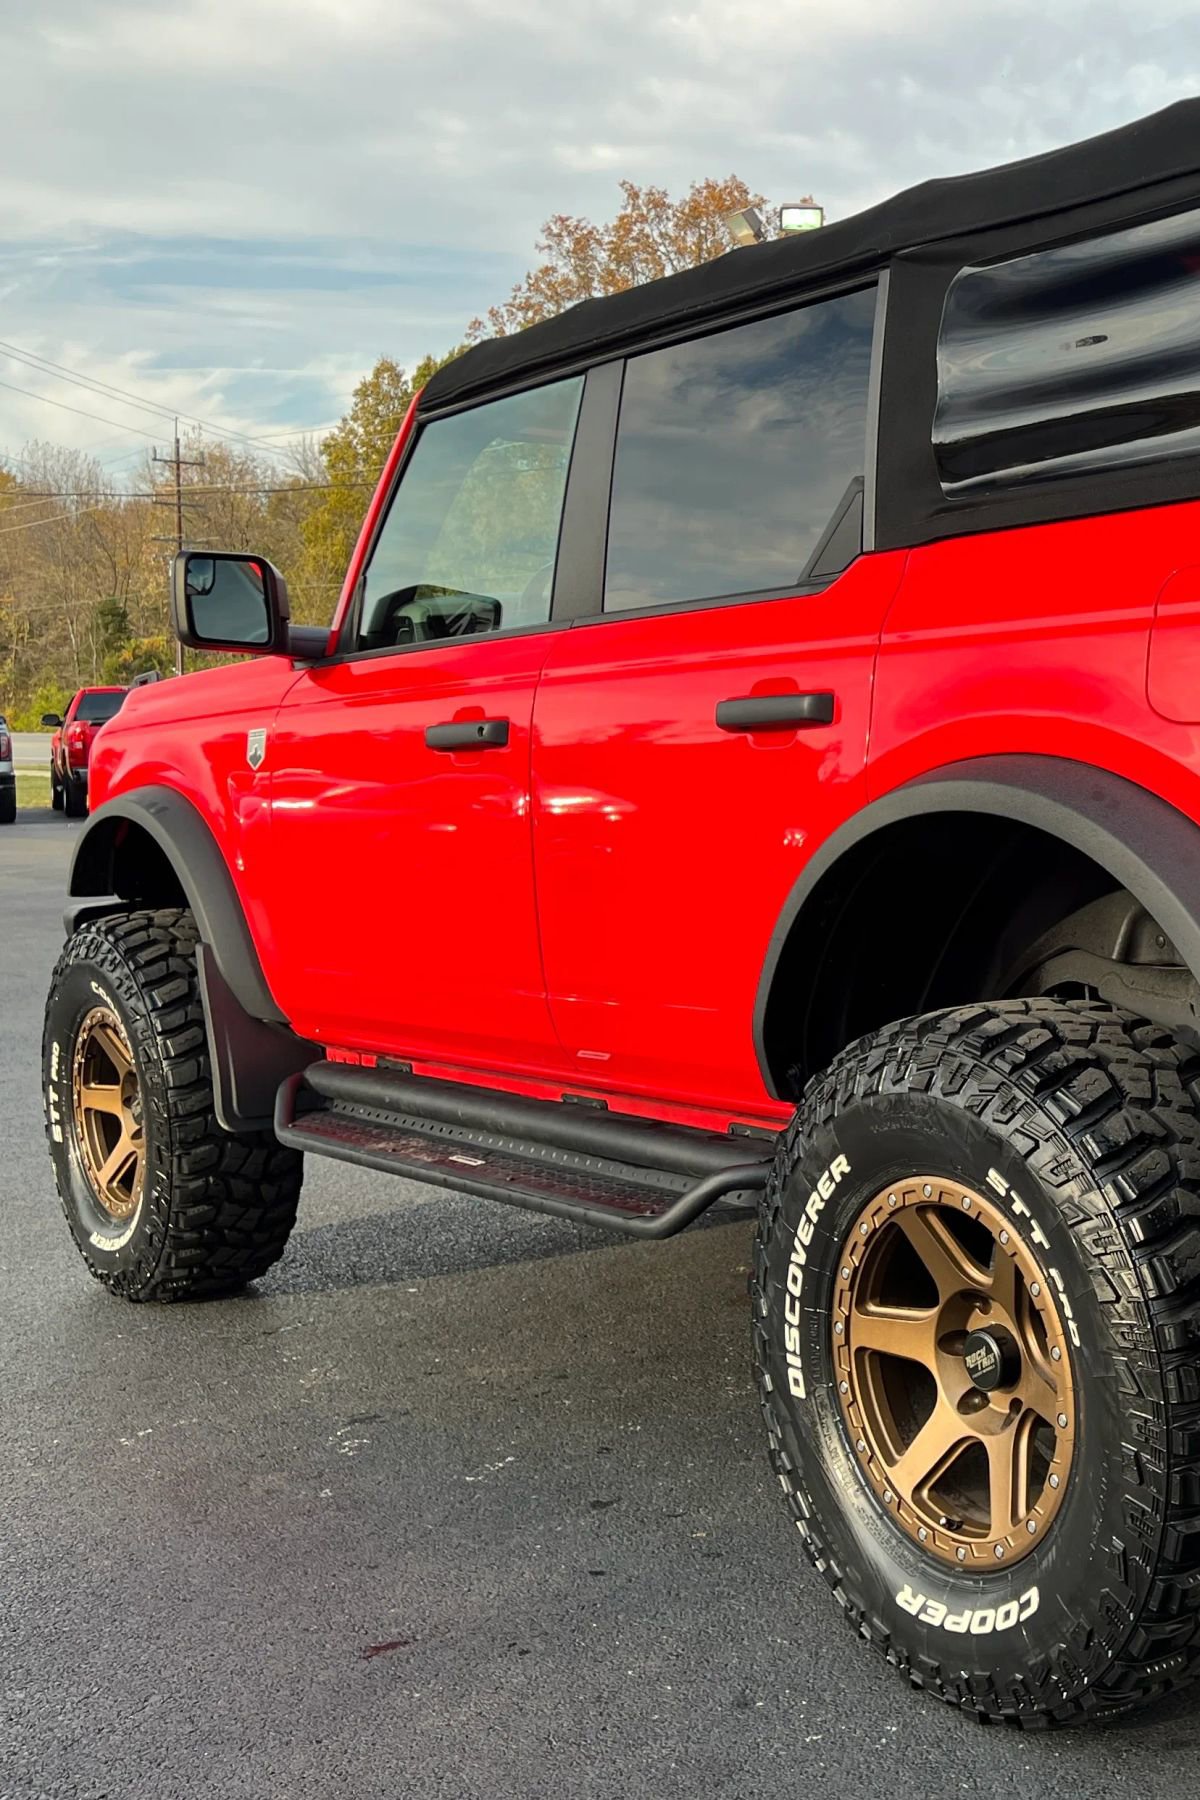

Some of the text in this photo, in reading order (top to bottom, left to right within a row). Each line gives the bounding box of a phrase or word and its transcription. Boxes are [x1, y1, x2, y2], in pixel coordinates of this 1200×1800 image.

[49, 1041, 63, 1143] STT PRO
[784, 1153, 852, 1400] DISCOVERER
[985, 1167, 1081, 1348] STT PRO
[965, 1345, 987, 1368] ROCK
[895, 1584, 1040, 1635] COOPER
